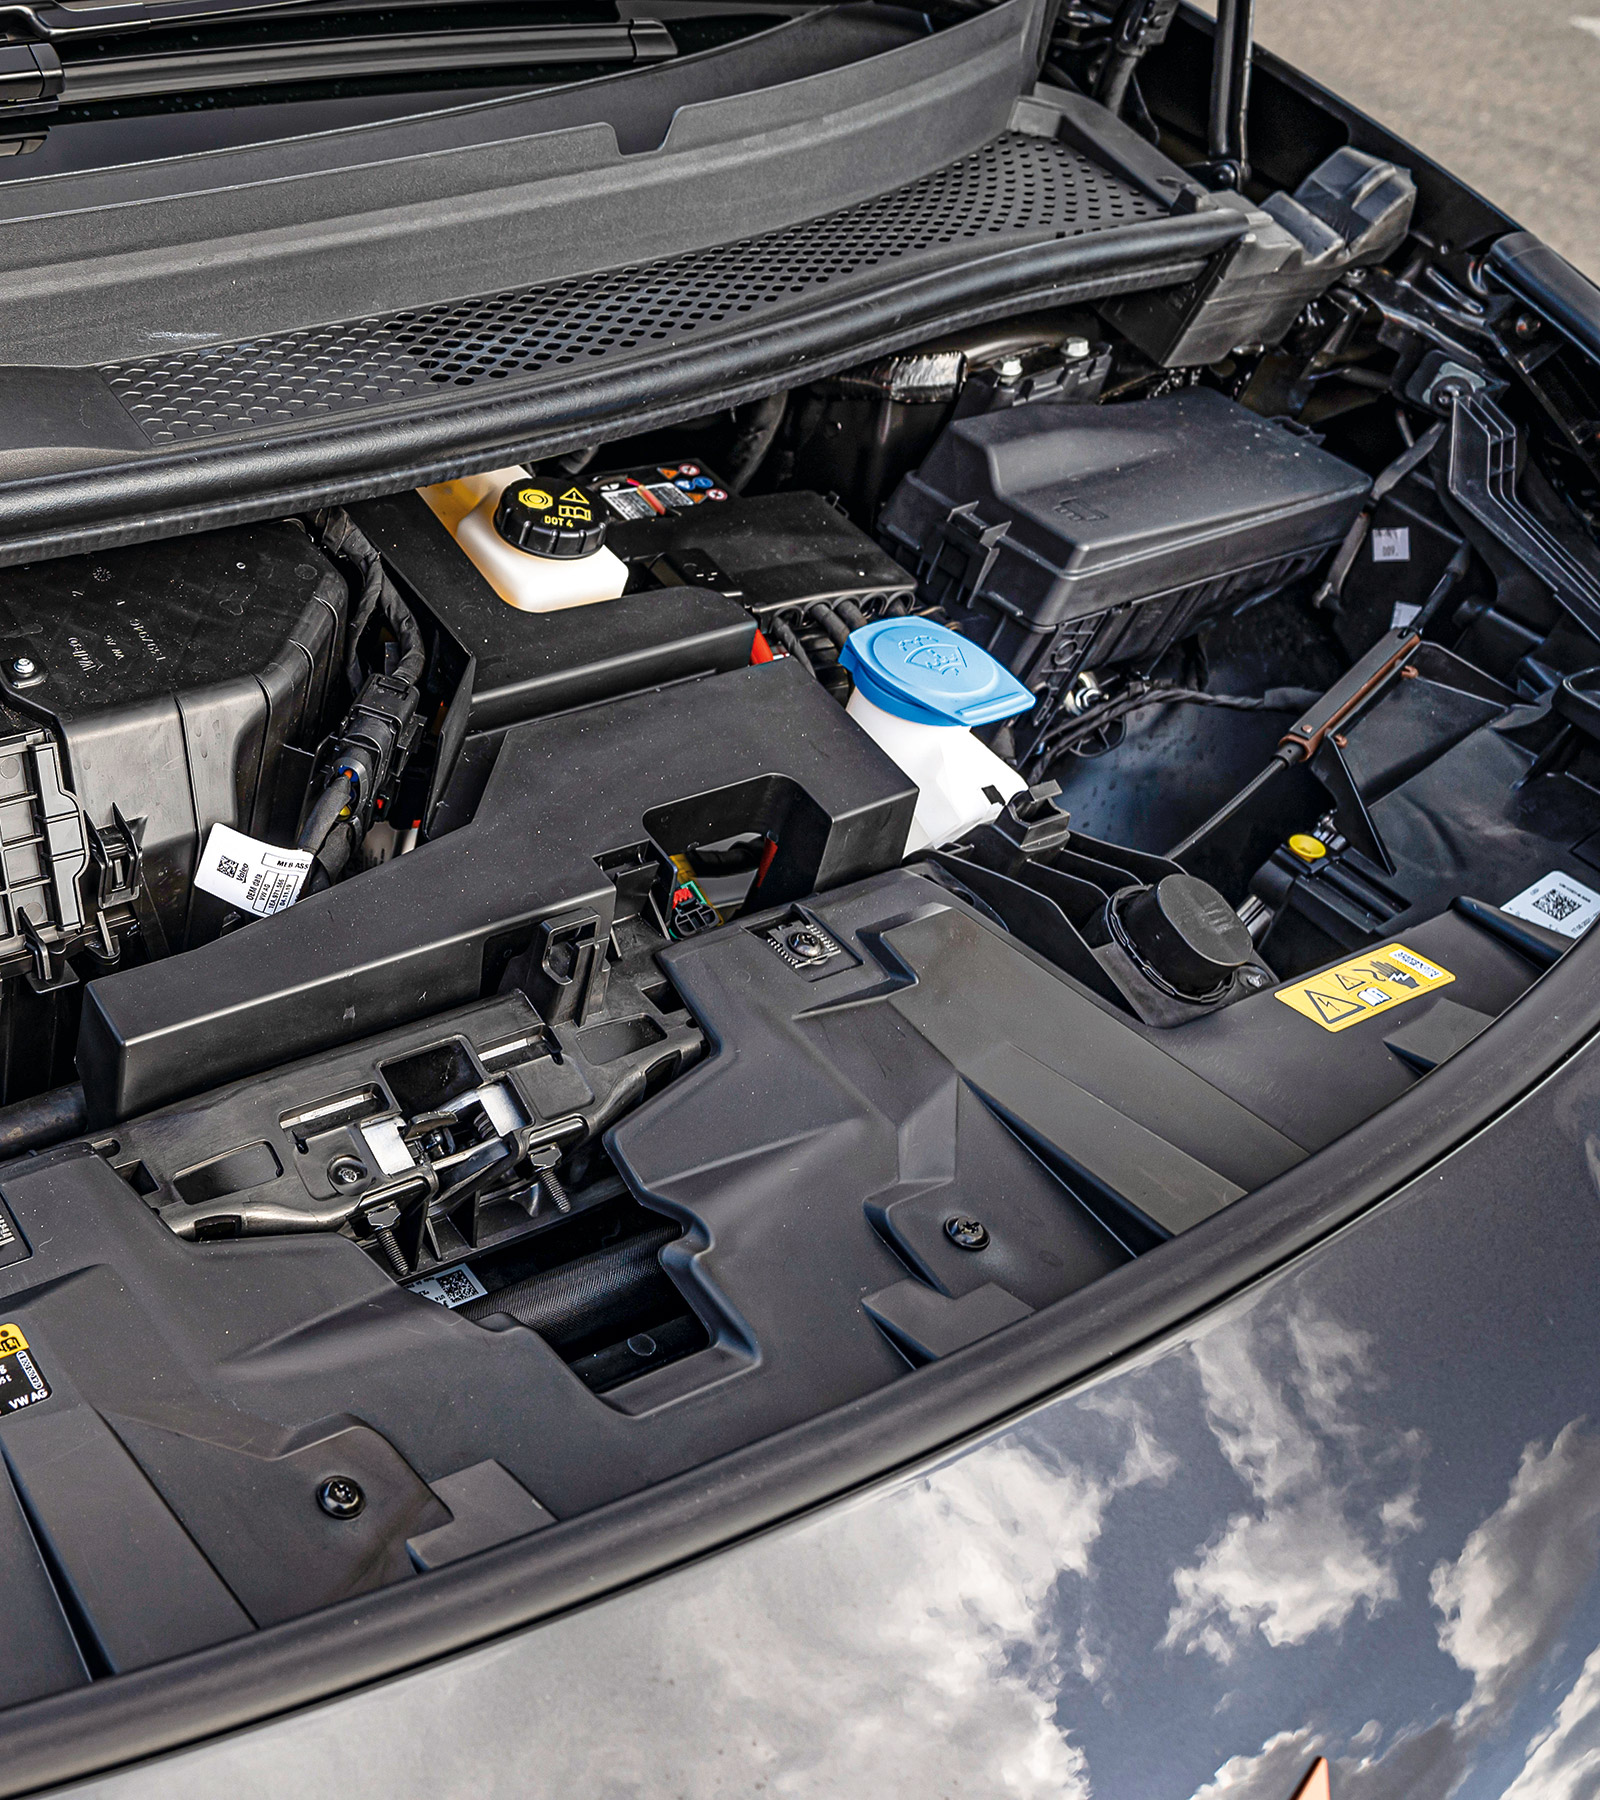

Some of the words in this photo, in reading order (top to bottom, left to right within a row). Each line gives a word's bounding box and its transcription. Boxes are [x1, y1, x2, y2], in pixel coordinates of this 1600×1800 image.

[544, 514, 565, 526] DOT
[566, 518, 574, 528] 4
[236, 862, 249, 882] Valeo
[245, 885, 257, 901] OEM
[252, 873, 263, 887] data
[5, 1373, 12, 1382] t
[8, 1394, 29, 1410] VW
[30, 1388, 48, 1403] AG
